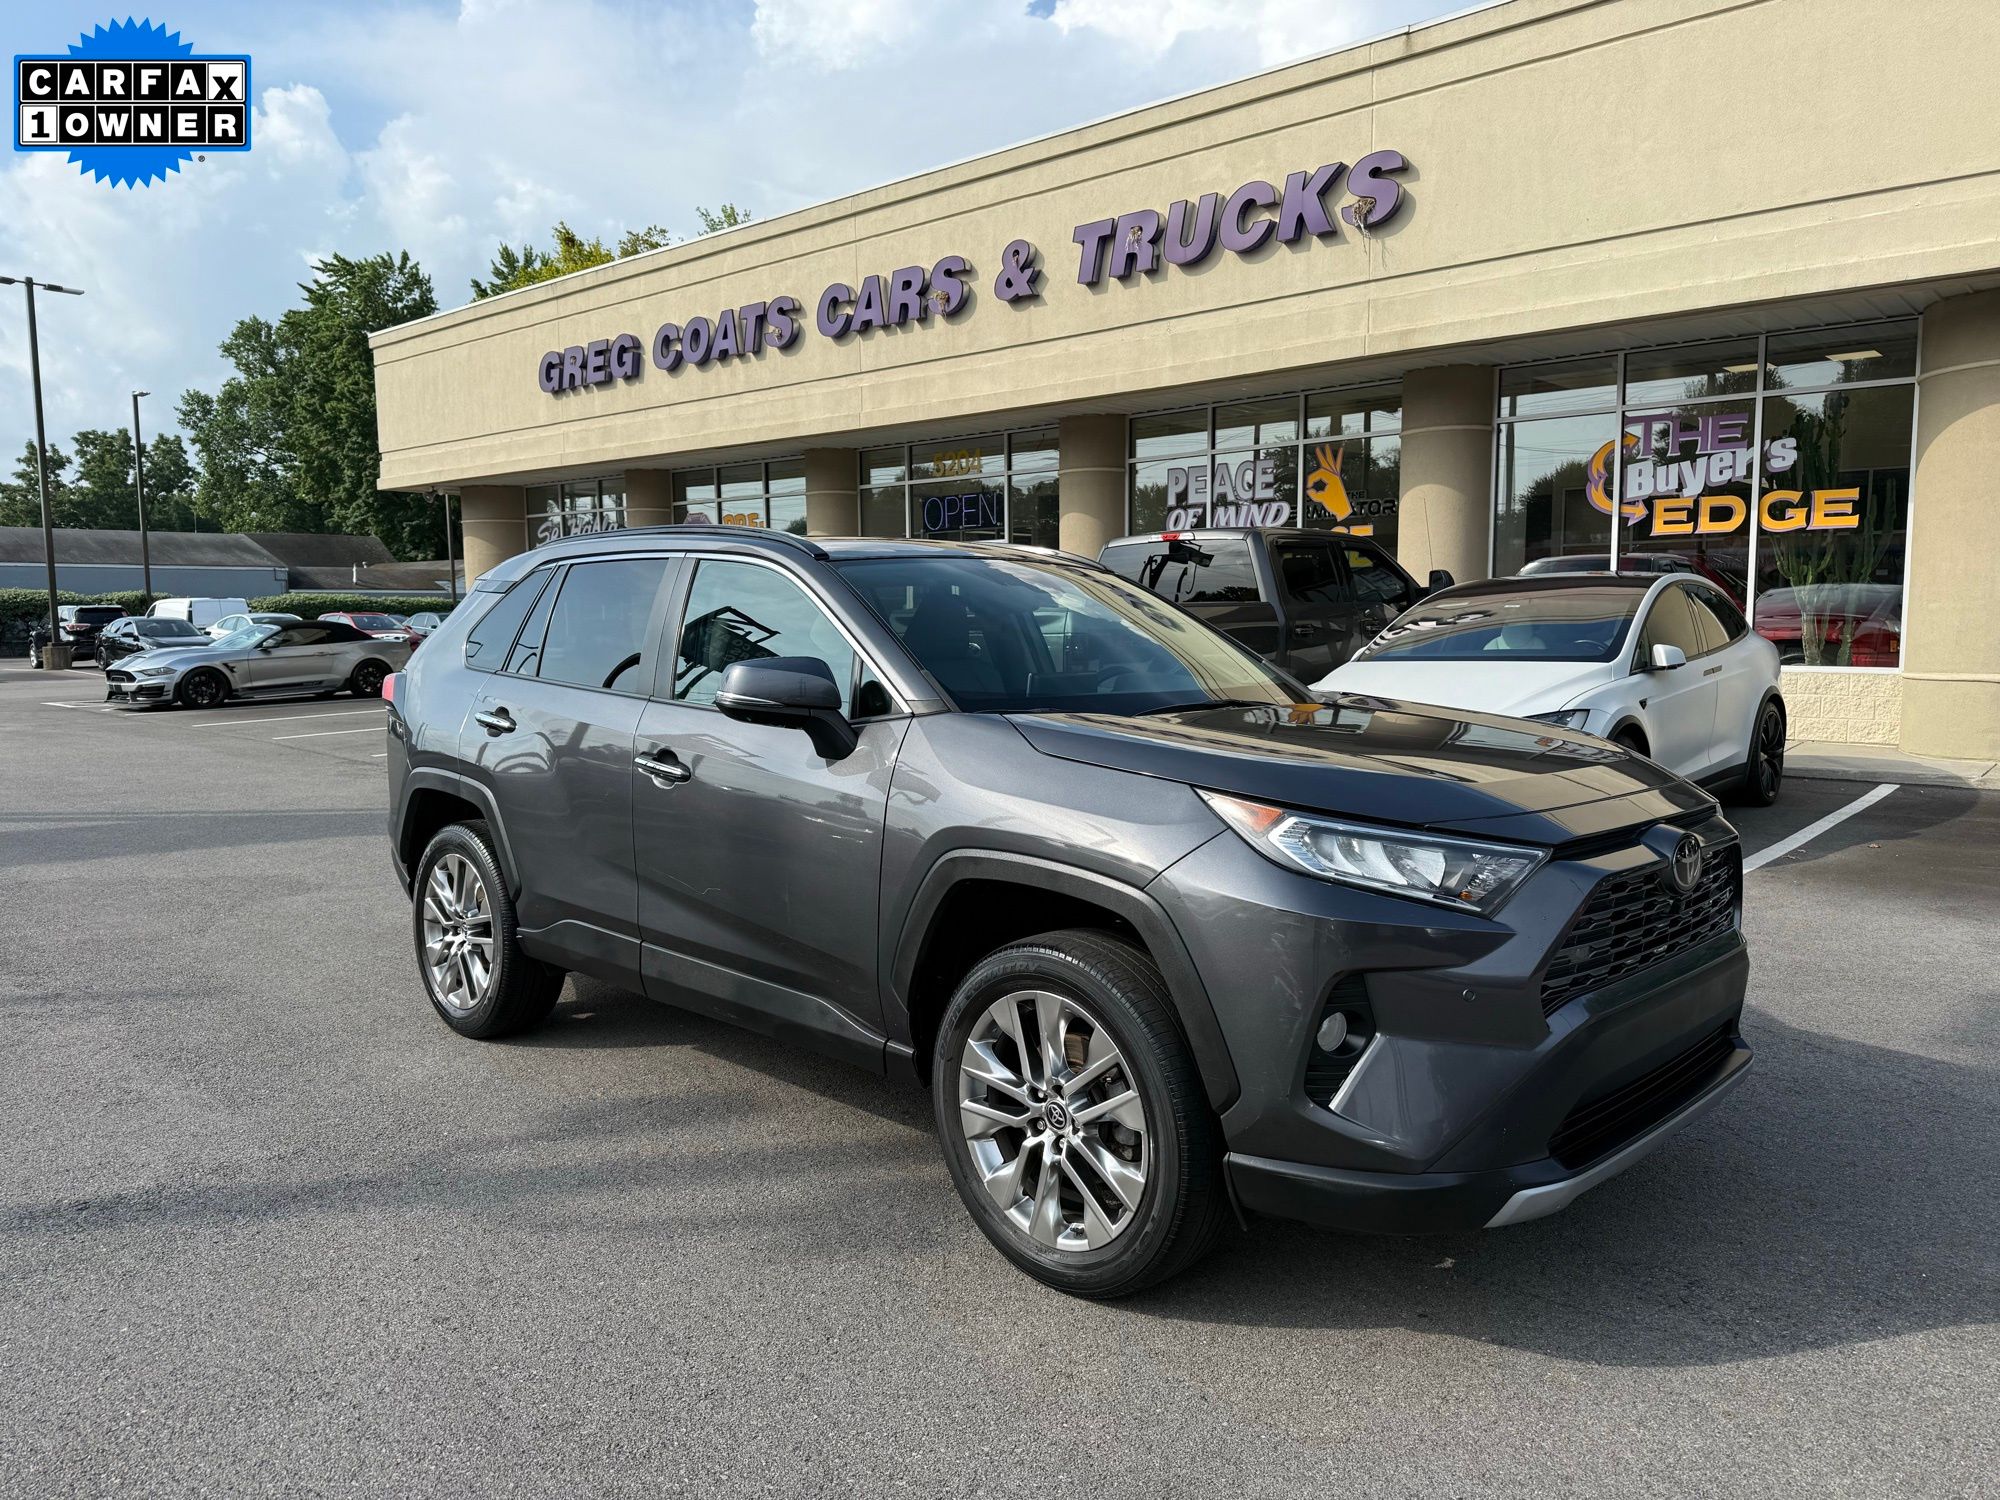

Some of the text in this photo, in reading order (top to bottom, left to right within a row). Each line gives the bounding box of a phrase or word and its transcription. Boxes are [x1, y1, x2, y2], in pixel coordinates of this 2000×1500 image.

[539, 150, 1408, 393] GREG COATS CARS & TRUCKS
[1625, 412, 1748, 459] THE
[931, 449, 983, 477] 5204
[1166, 460, 1275, 507] PEACE
[1624, 437, 1797, 499] Buyer's
[924, 492, 997, 530] OPEN
[1166, 501, 1290, 530] OF MIND
[1650, 487, 1860, 537] EDGE
